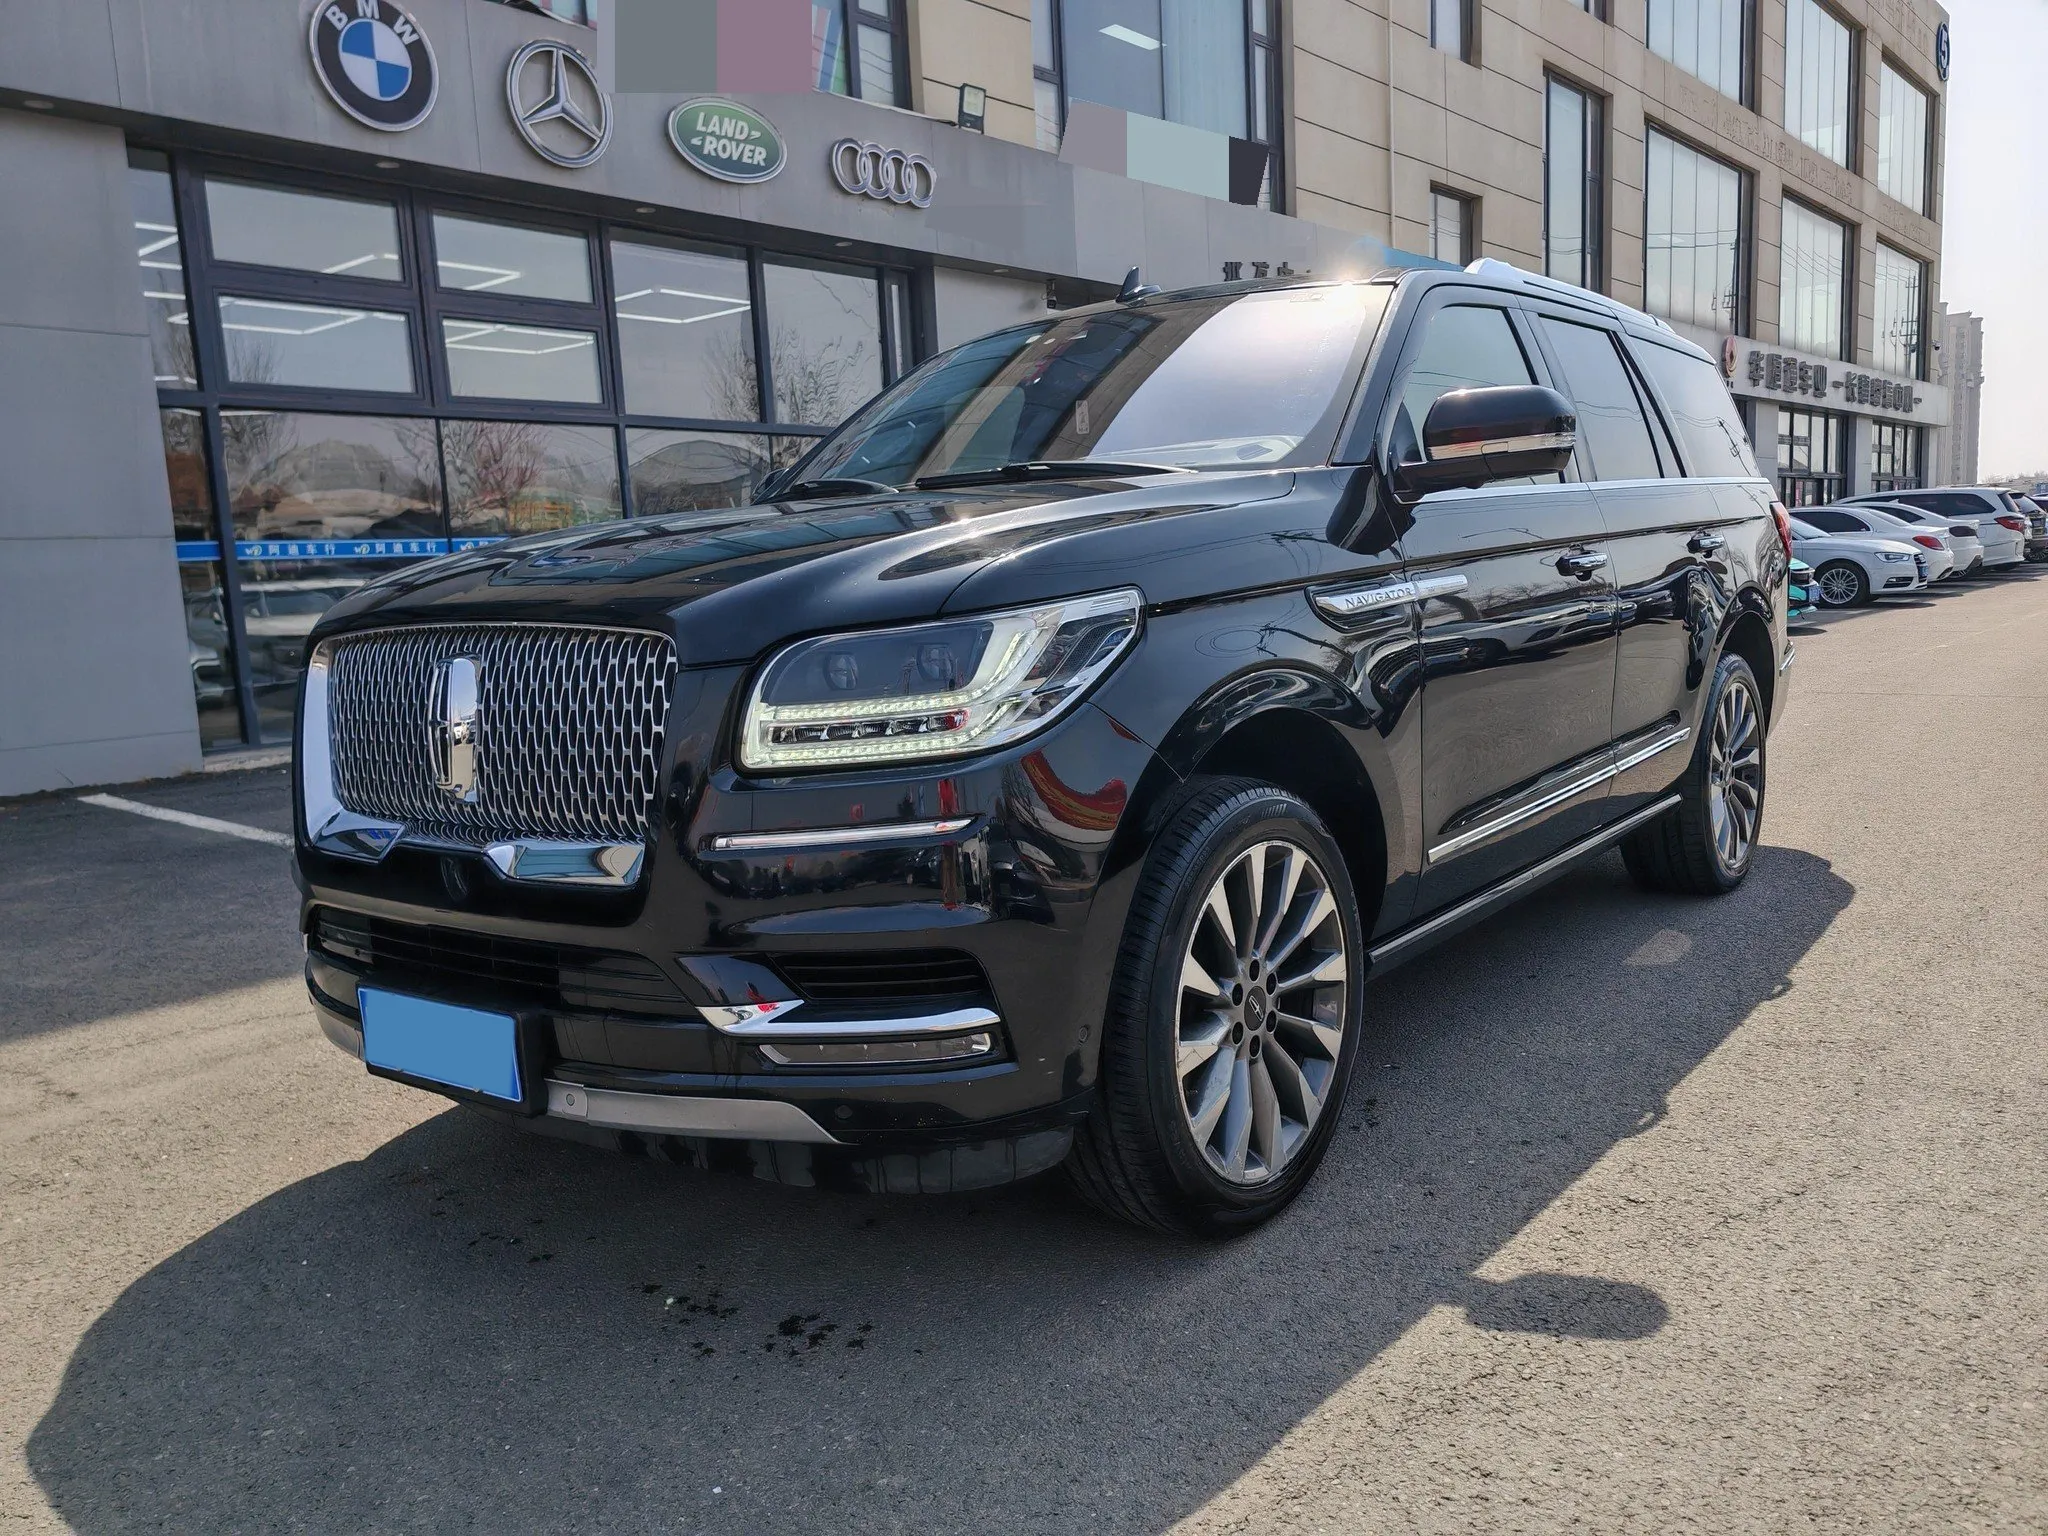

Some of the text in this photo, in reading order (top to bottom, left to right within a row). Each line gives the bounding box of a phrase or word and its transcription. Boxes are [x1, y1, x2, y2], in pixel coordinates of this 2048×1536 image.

[325, 0, 420, 45] BMW
[696, 111, 749, 140] LAND
[703, 135, 767, 166] ROVER
[1345, 587, 1412, 609] NAVIGATOR
